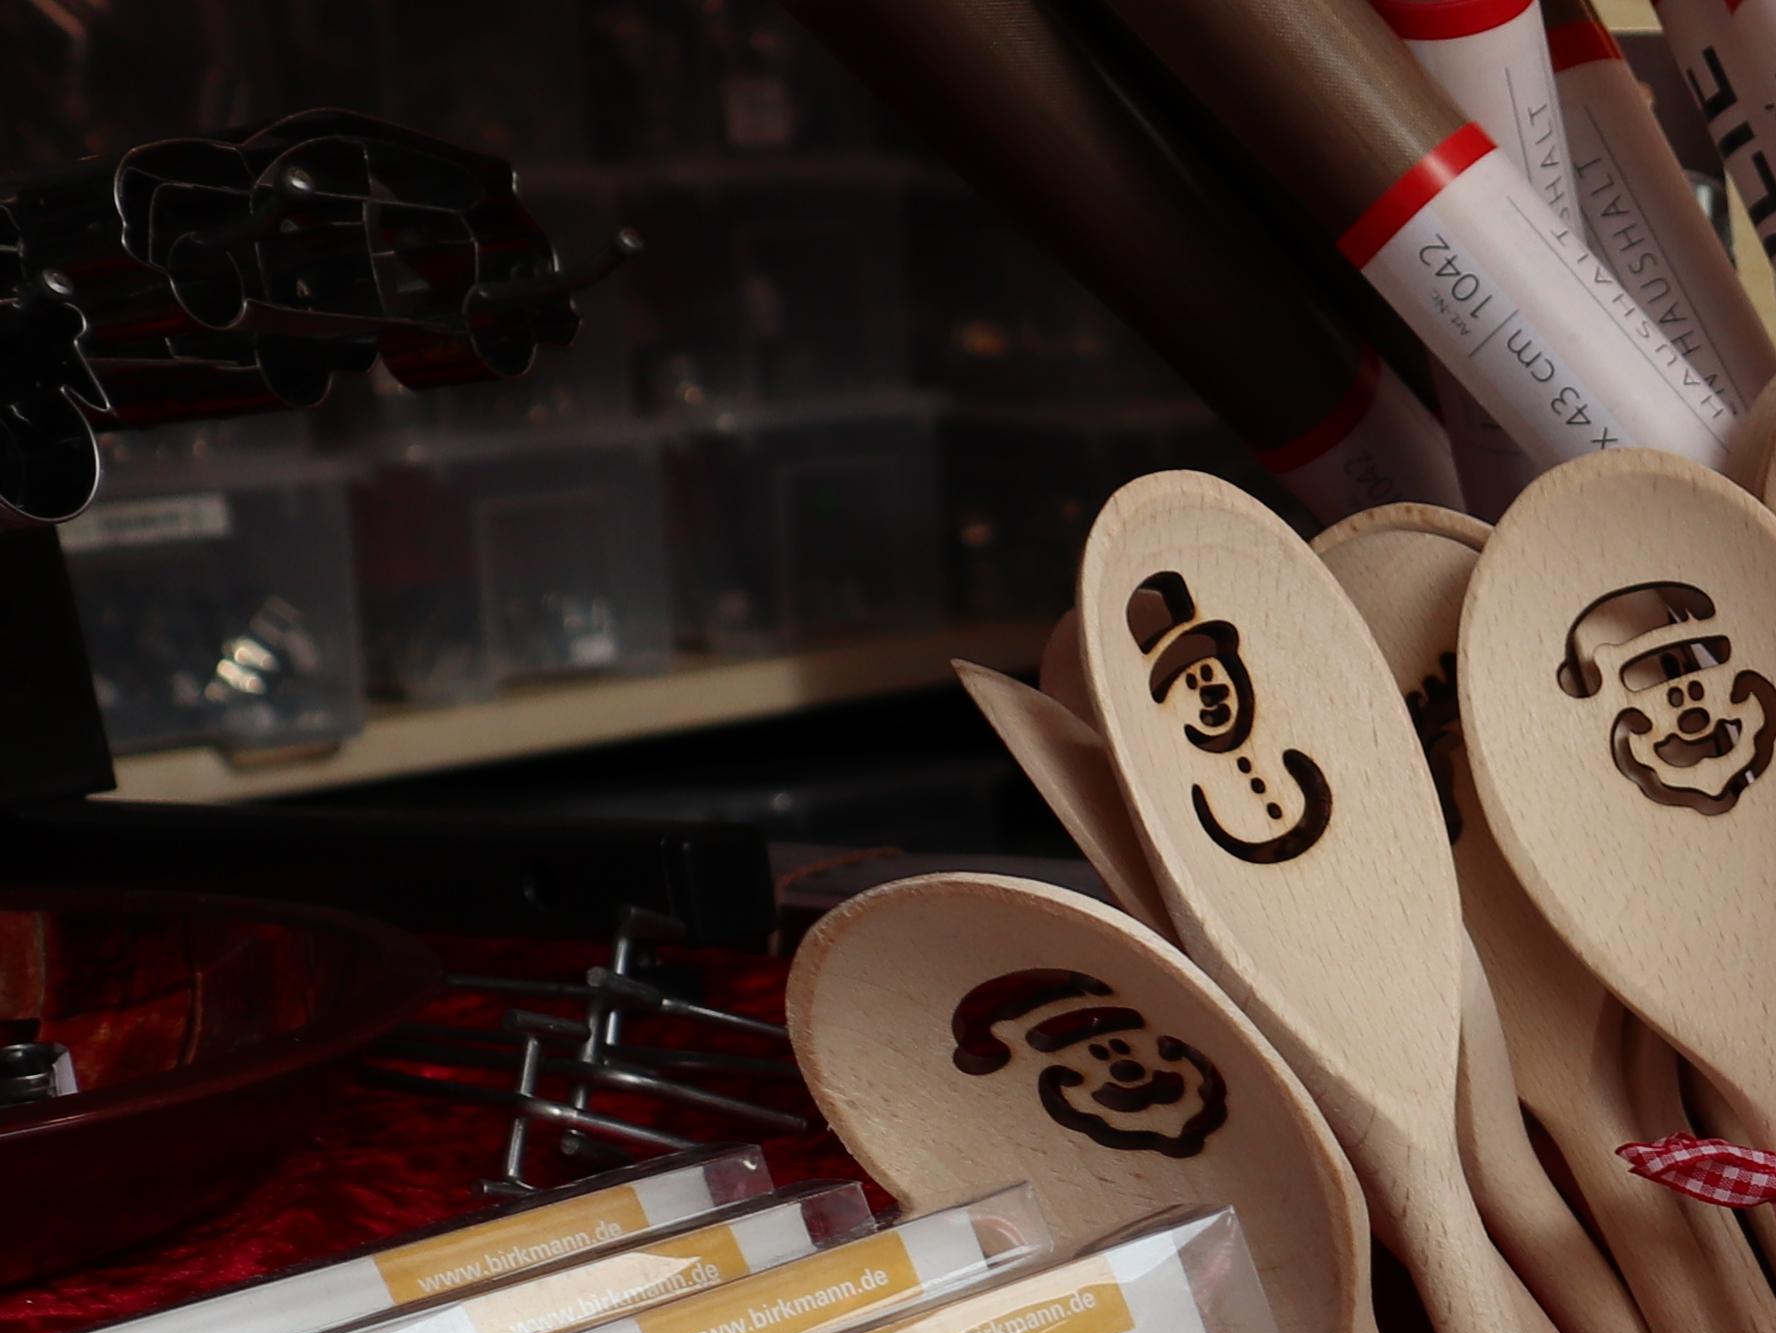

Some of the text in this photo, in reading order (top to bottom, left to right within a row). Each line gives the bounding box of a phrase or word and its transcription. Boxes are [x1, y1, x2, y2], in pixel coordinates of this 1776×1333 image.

[1418, 233, 1493, 321] 1042
[1507, 328, 1556, 384] cm
[1550, 386, 1592, 428] 43
[417, 1219, 624, 1293] www.birkmann.de
